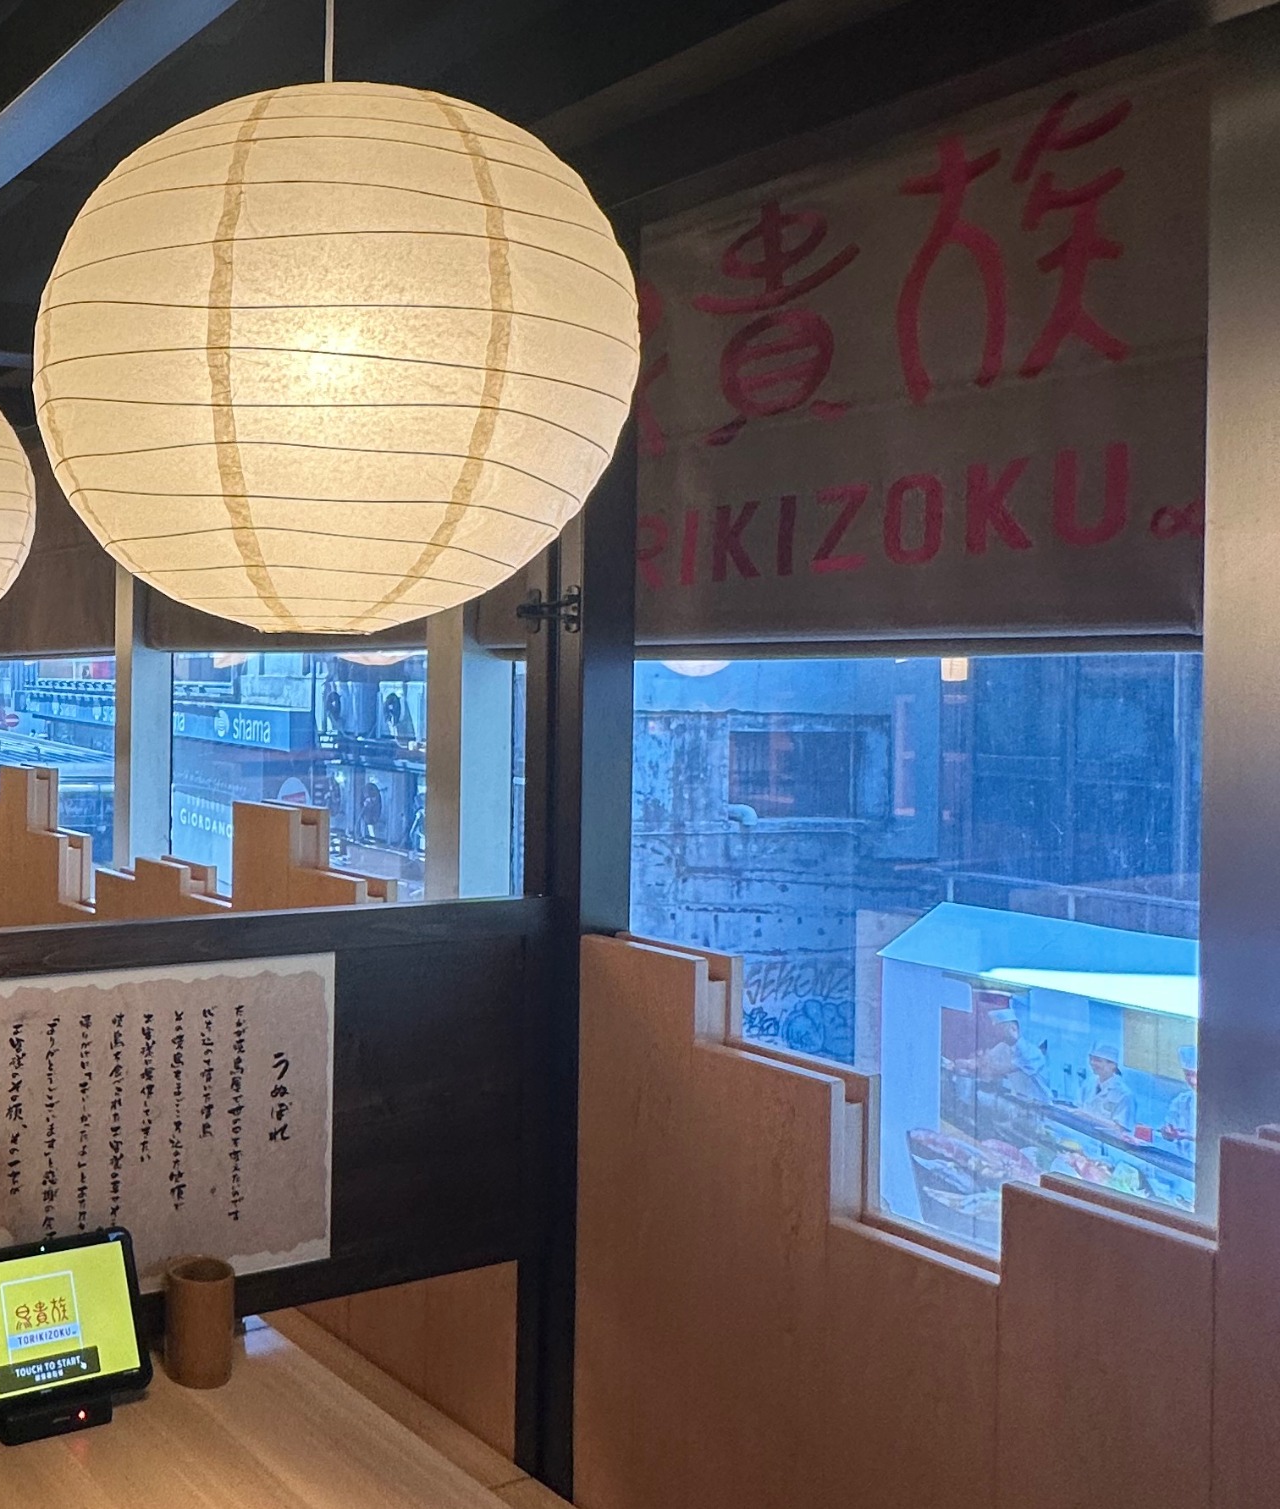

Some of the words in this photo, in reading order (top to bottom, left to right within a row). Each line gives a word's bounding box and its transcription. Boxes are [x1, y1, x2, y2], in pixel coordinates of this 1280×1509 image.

[638, 92, 1132, 455] 貴族
[232, 711, 271, 744] shama
[179, 807, 233, 838] GIORDANO
[269, 1052, 292, 1142] うぬぼれ
[15, 1296, 69, 1331] 鳥貴族
[17, 1327, 72, 1346] TORIKIZOKU
[14, 1364, 43, 1378] TOUCH
[44, 1361, 56, 1371] TO
[57, 1355, 81, 1369] START
